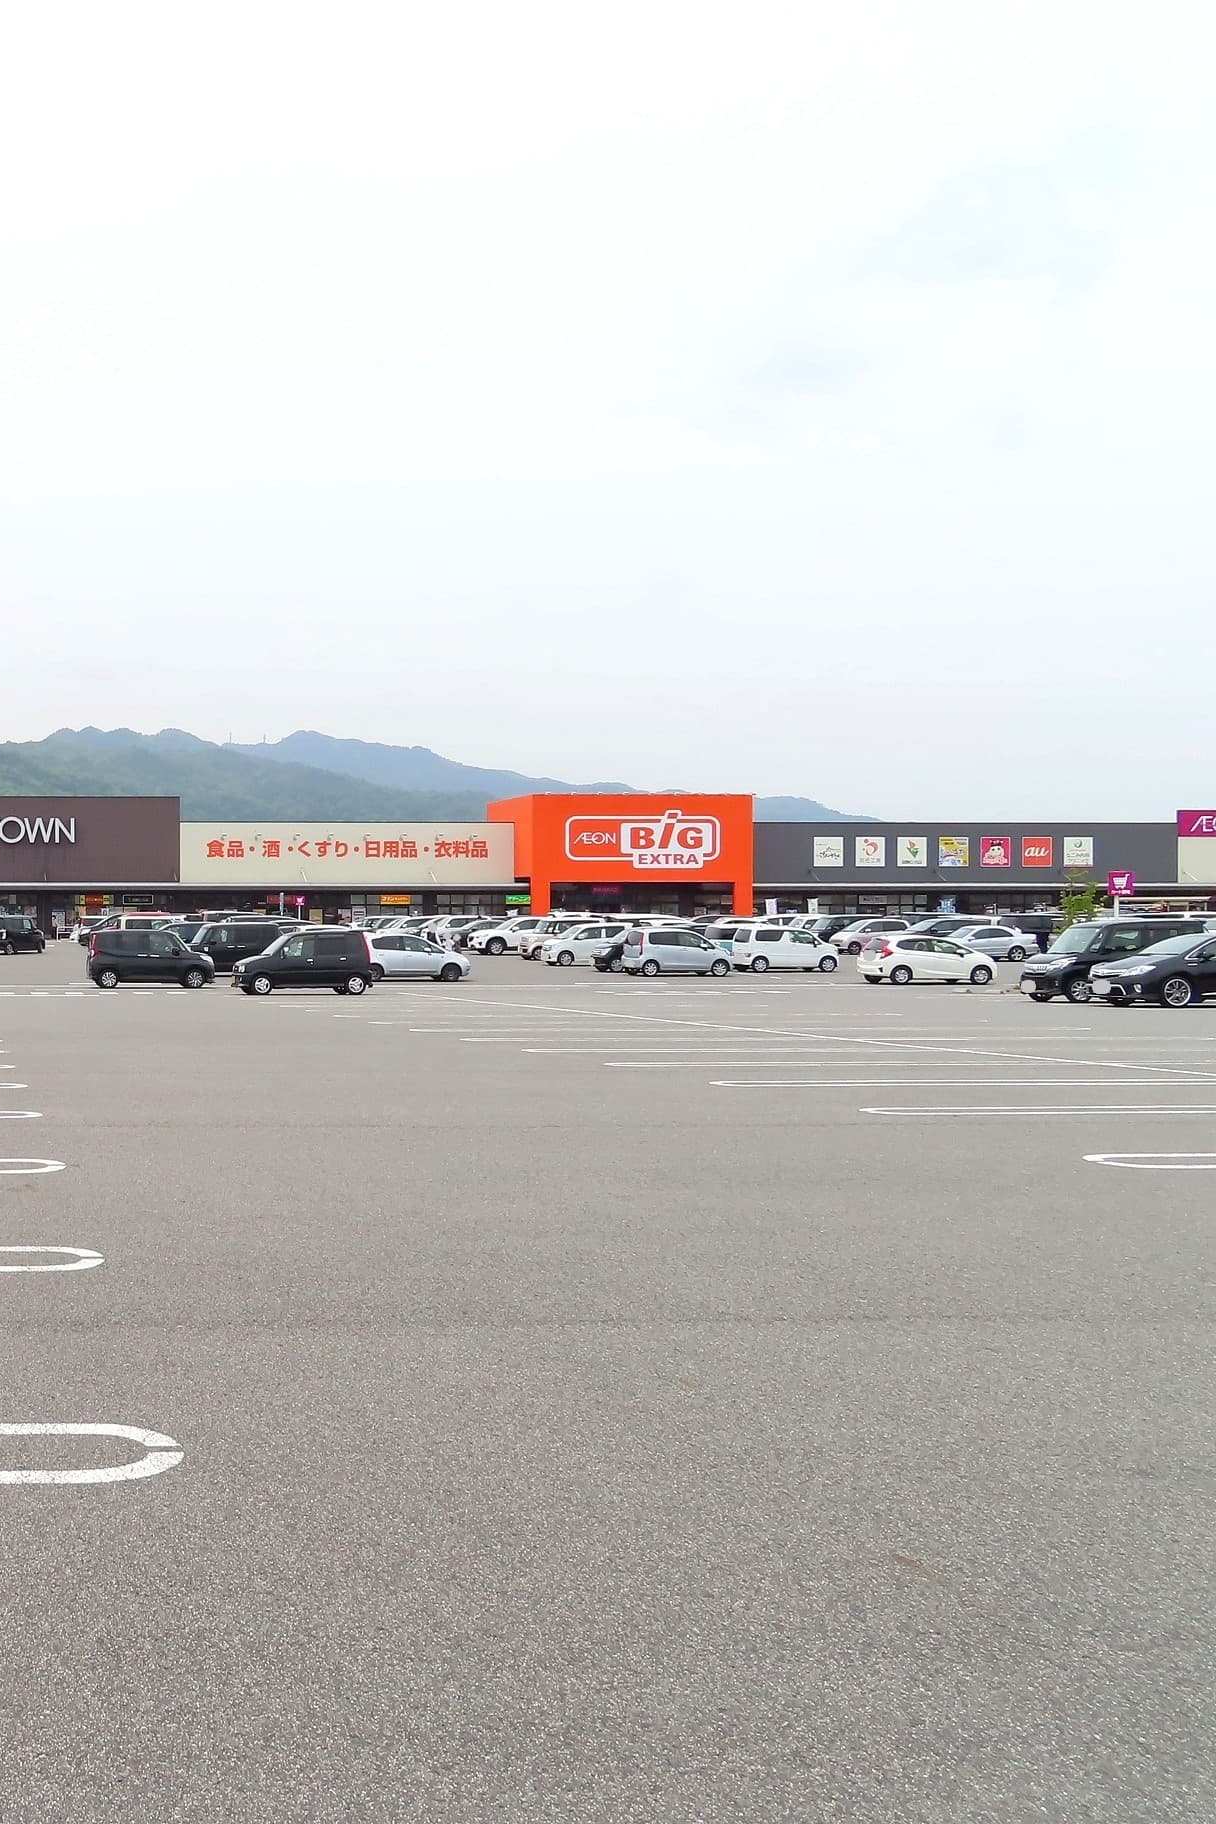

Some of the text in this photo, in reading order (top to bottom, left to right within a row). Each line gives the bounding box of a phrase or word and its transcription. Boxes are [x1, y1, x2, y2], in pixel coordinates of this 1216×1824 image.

[205, 839, 490, 859] 食品・酒・くすり・日用品・衣料品
[1024, 846, 1050, 858] au
[637, 853, 700, 865] EXTRA
